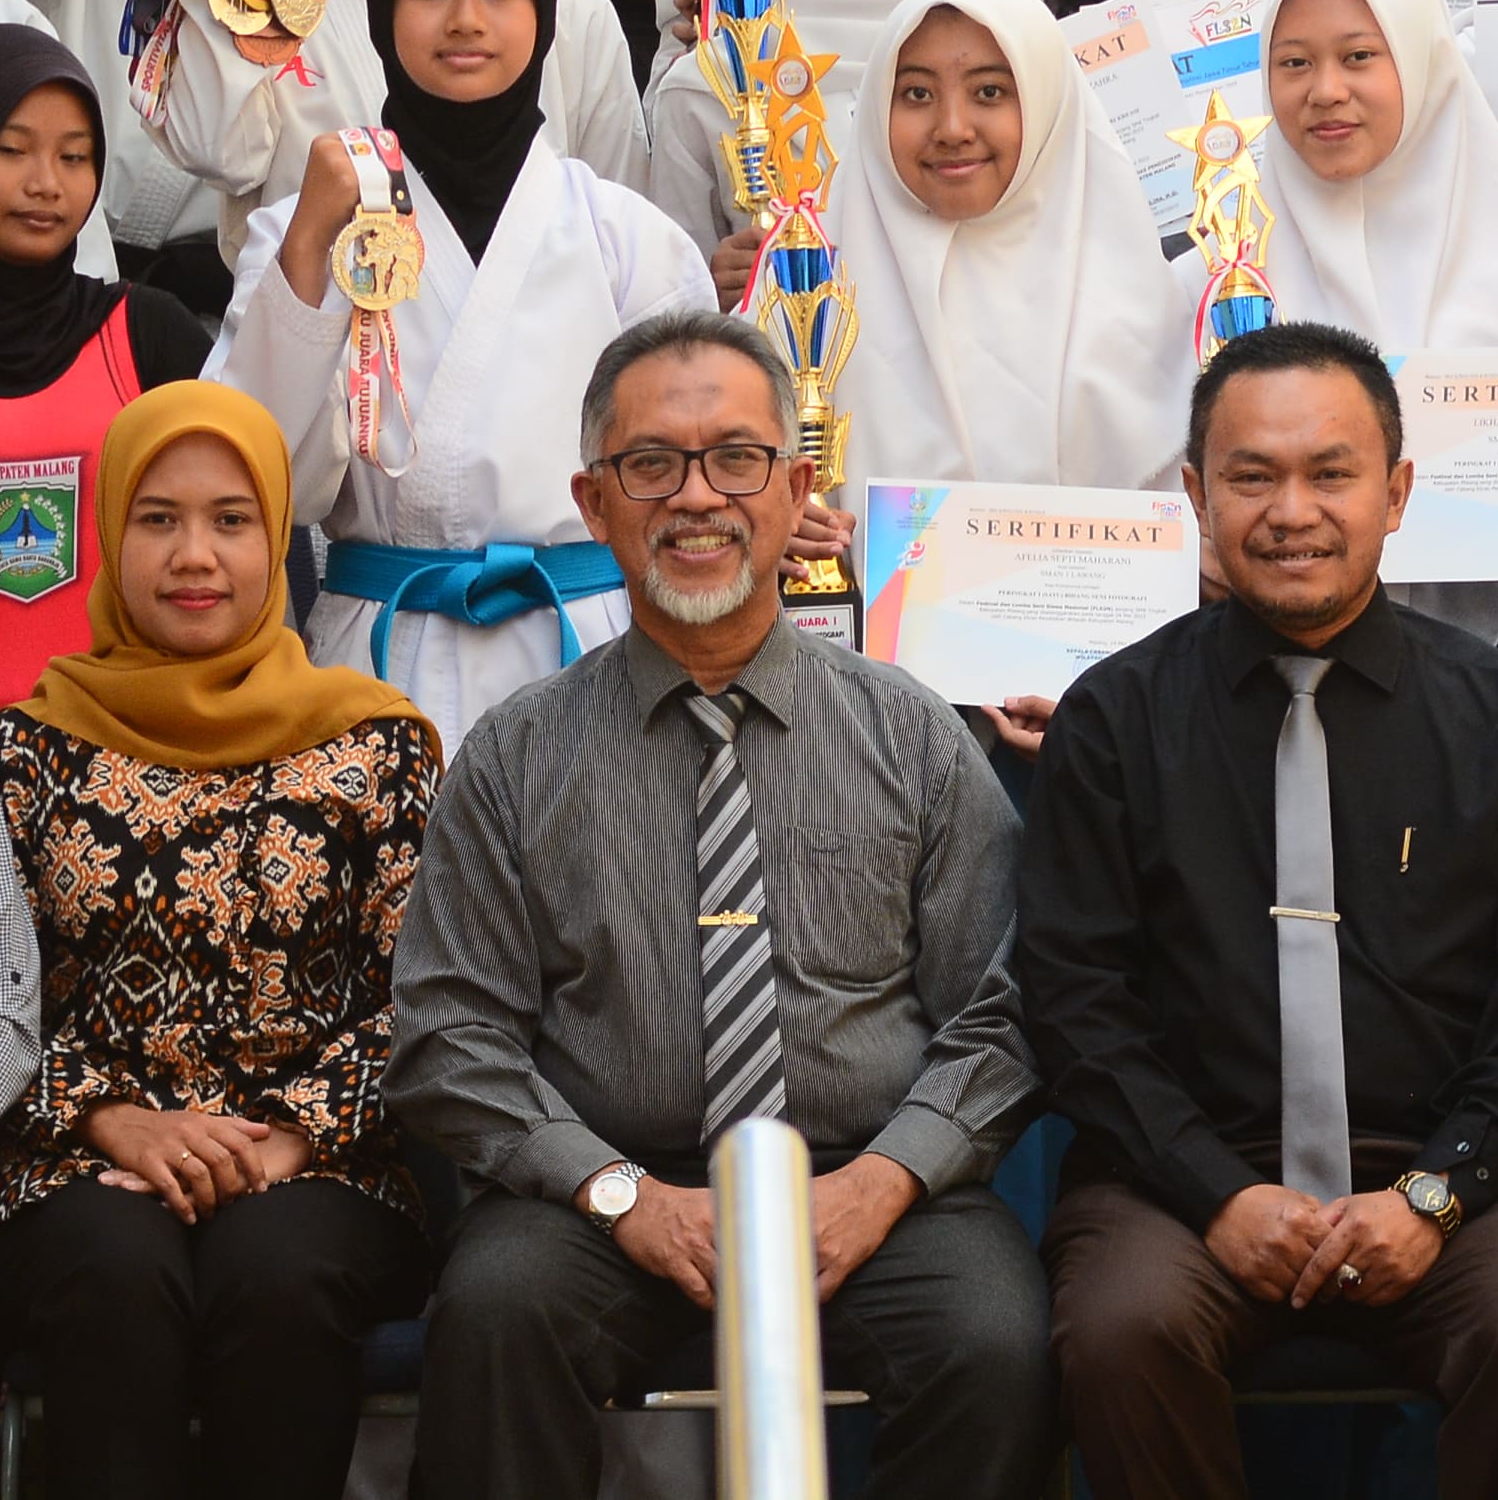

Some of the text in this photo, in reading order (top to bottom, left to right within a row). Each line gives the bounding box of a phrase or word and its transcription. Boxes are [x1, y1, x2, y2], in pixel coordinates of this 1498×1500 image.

[33, 460, 75, 477] MALANG
[966, 518, 1163, 543] SERTIFIKAT
[797, 616, 829, 628] JUARA
